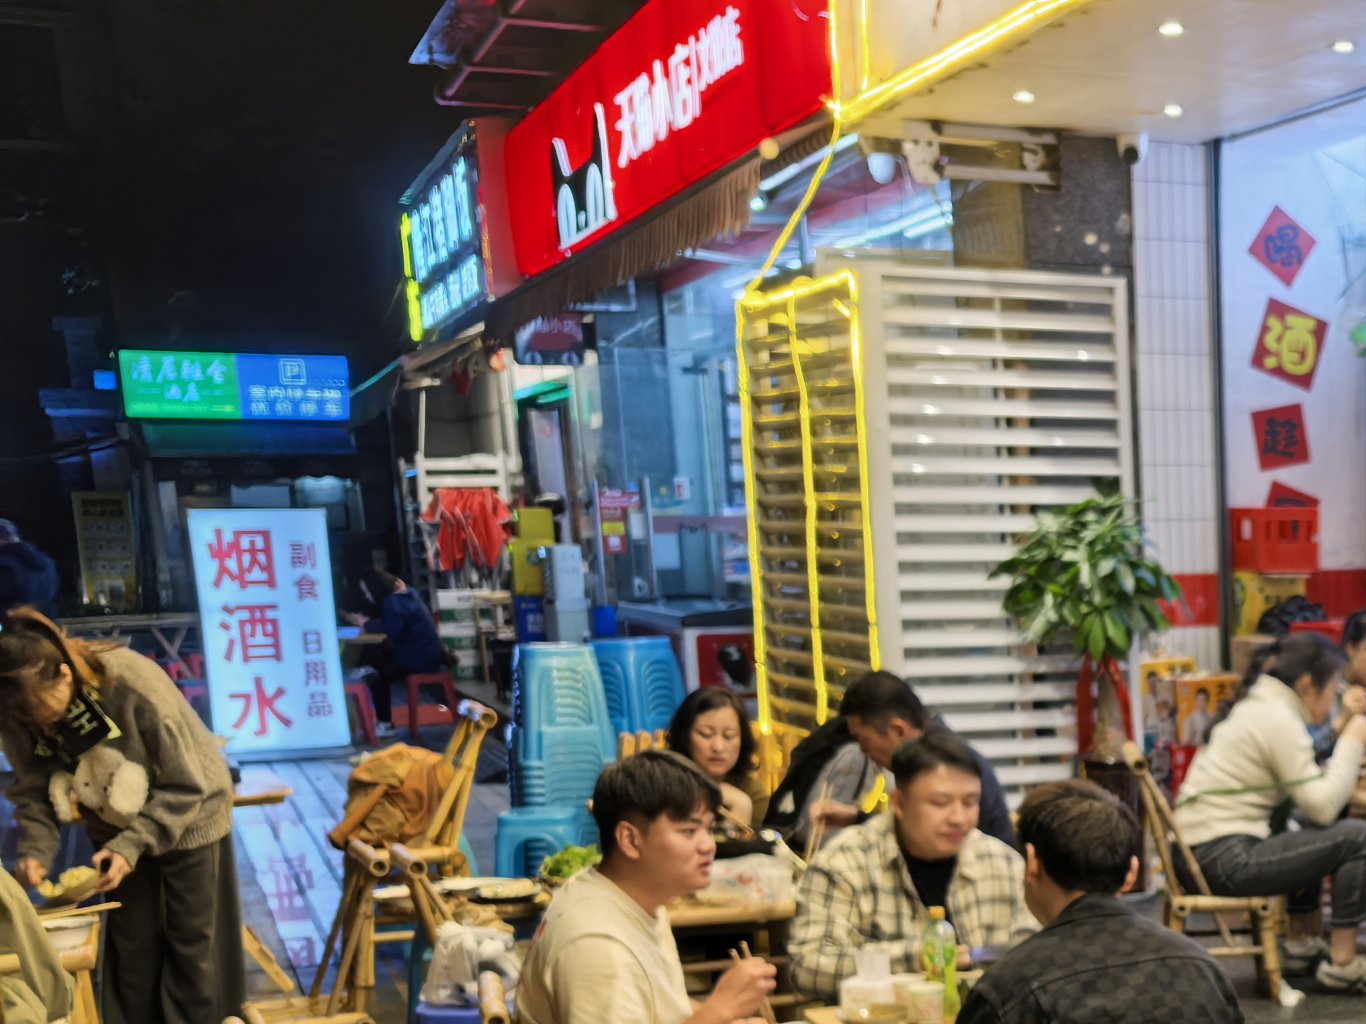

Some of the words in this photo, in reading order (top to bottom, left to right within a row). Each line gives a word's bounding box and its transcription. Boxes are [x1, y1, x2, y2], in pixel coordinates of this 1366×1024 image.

[289, 541, 320, 602] 副食
[207, 528, 293, 736] 烟酒水
[303, 630, 333, 718] 日用品
